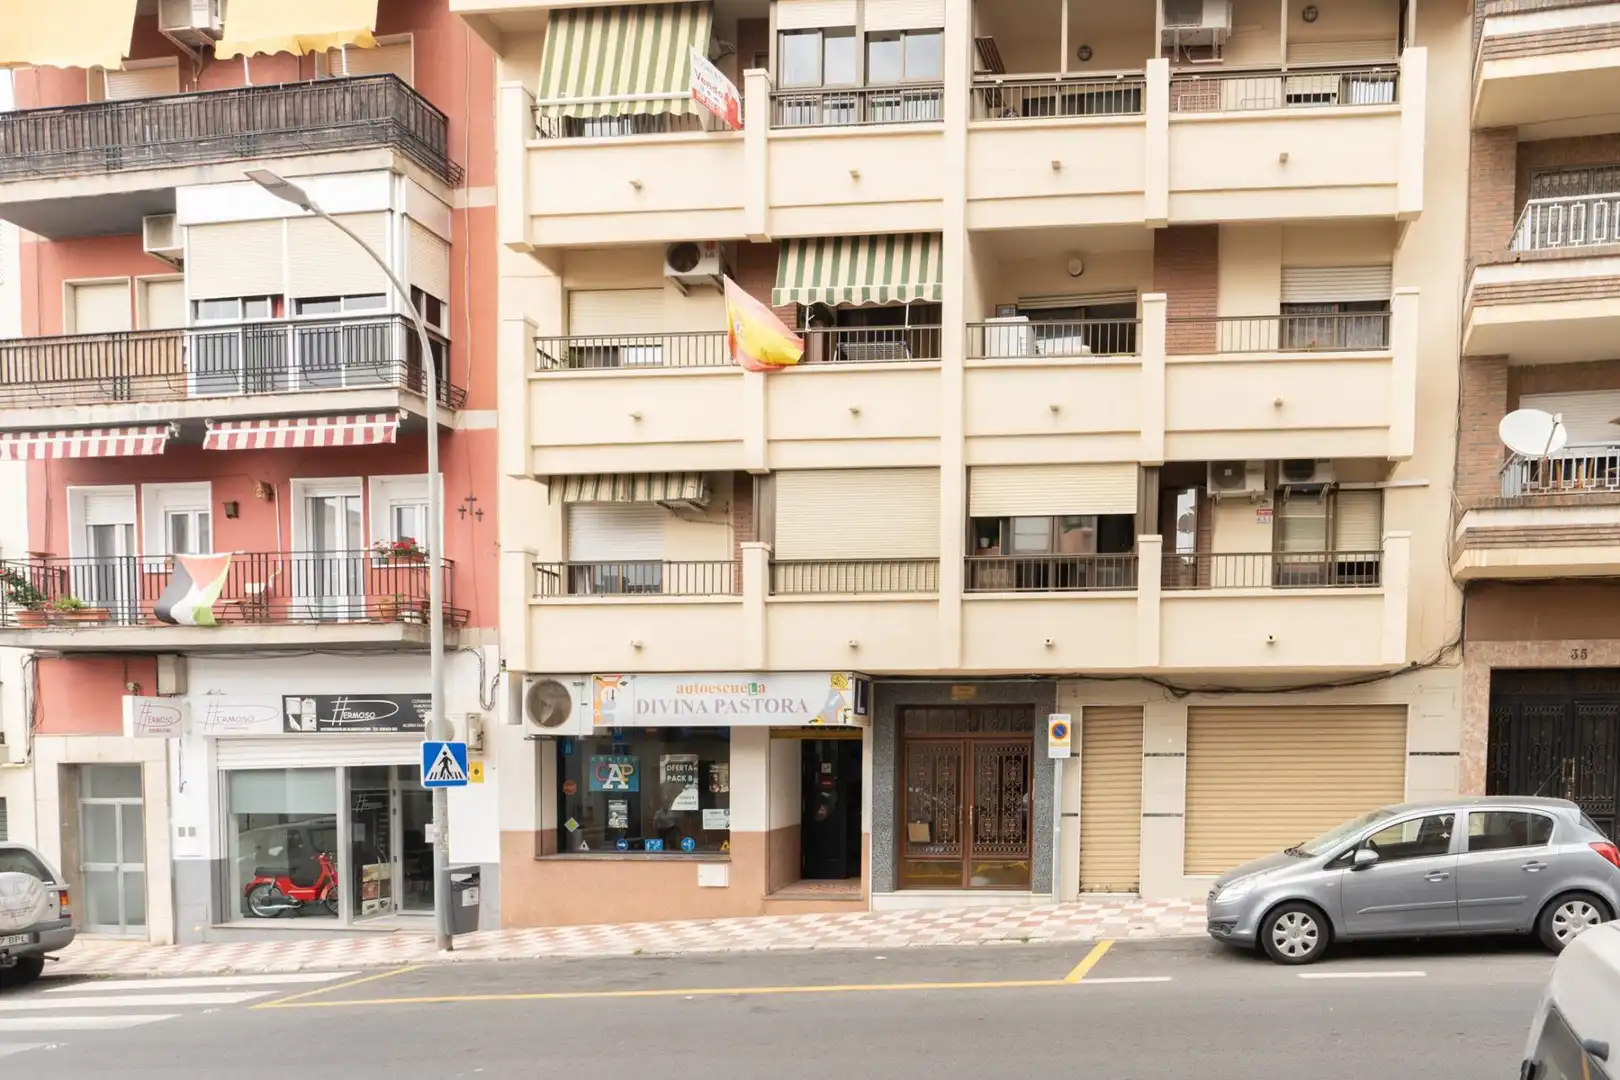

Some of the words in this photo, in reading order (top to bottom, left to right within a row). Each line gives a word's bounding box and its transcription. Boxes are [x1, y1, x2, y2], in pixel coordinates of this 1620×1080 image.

[1571, 648, 1588, 660] 35
[329, 696, 378, 726] HERMOSO
[636, 698, 708, 715] DIVINA
[714, 697, 808, 714] PASTORA
[666, 764, 693, 772] OFERTA
[595, 763, 634, 789] CAP
[666, 774, 687, 782] PACK
